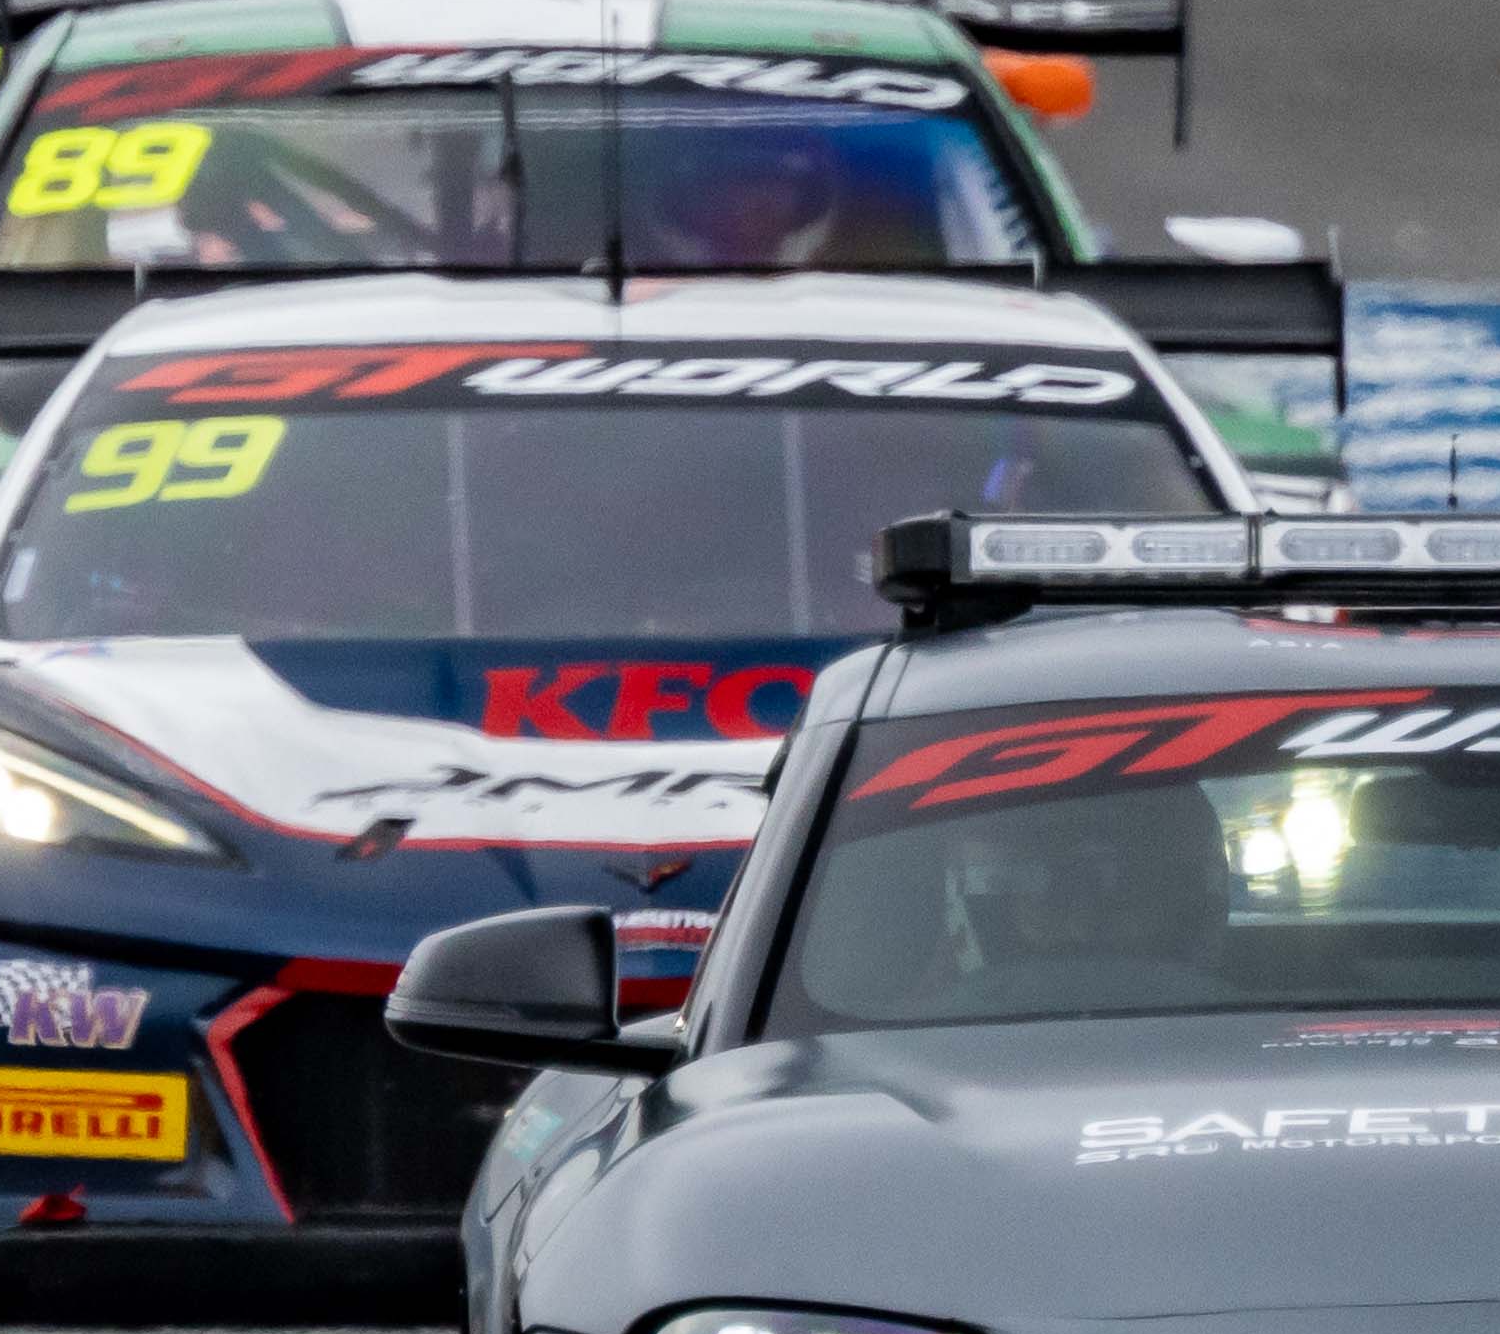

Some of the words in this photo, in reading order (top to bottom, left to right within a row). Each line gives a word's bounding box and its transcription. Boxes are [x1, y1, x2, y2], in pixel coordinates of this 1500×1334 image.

[351, 47, 967, 108] WORLD
[7, 121, 213, 217] 89
[116, 341, 594, 405] GT
[461, 356, 1137, 405] WORLD
[62, 415, 287, 514] 99
[480, 661, 818, 741] KFC
[845, 684, 1436, 810] GT
[8, 986, 150, 1050] KW
[1075, 1142, 1219, 1166] SRO
